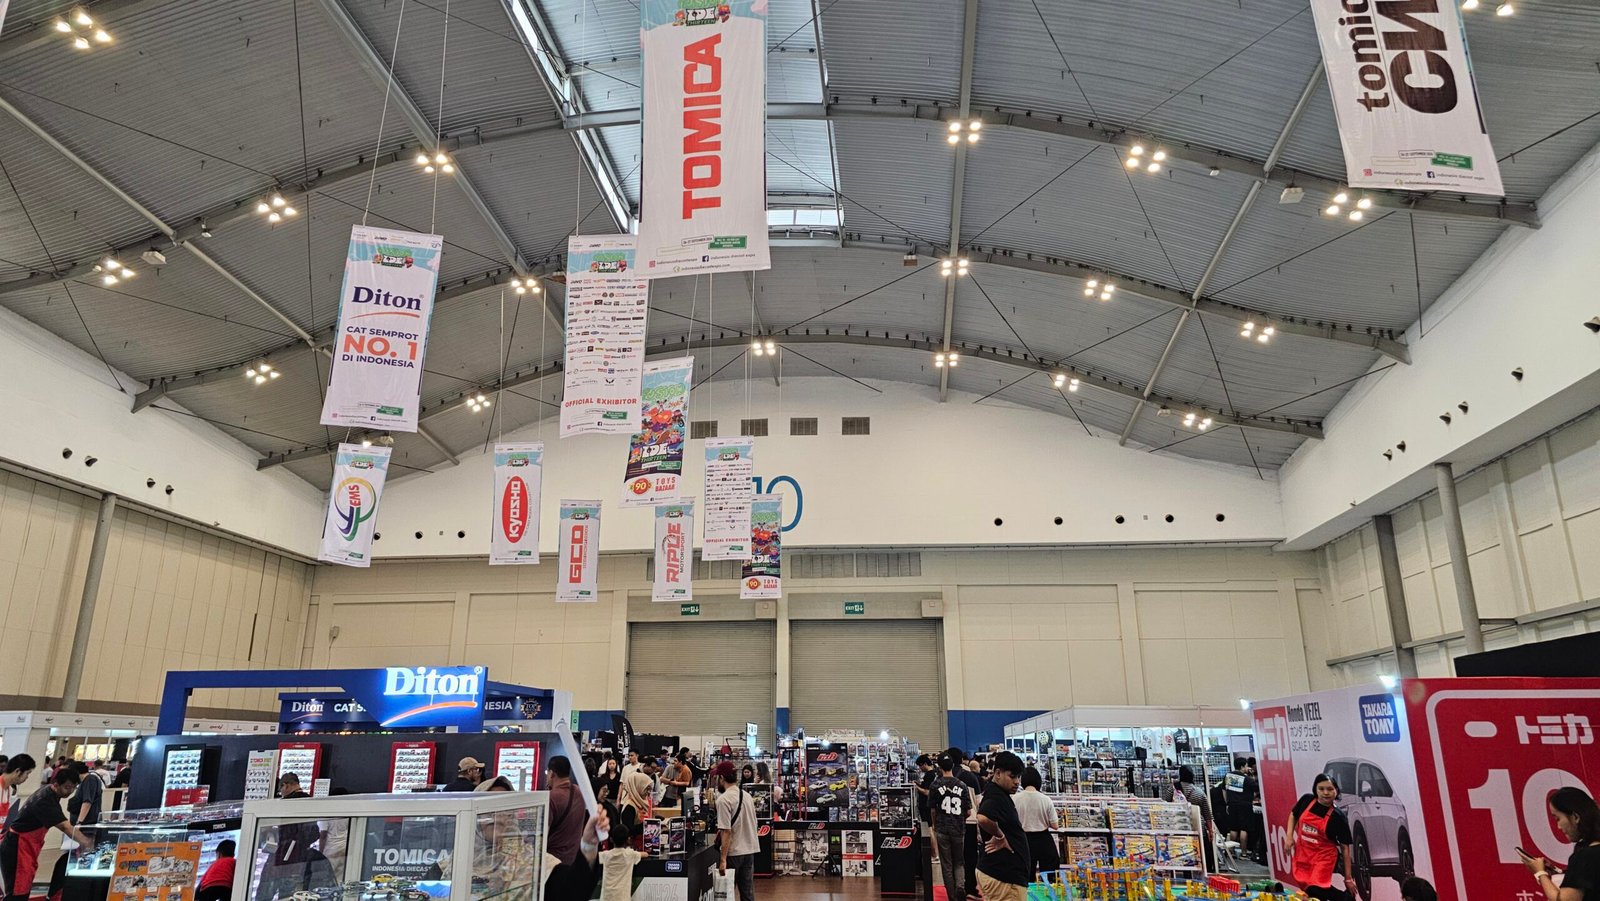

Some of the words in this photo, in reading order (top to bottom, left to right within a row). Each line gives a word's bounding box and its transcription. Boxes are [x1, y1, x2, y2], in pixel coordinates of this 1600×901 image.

[682, 33, 722, 219] TOMICA
[351, 286, 421, 310] Diton
[346, 325, 367, 334] CAT
[369, 328, 419, 340] SEMPROT
[343, 334, 397, 358] NO.
[407, 341, 418, 360] 1
[341, 354, 353, 362] DI
[356, 355, 415, 369] INDONESIA
[564, 398, 594, 408] OFFICIAL
[596, 398, 637, 406] EXHIBITOR
[656, 477, 676, 485] TOYS
[349, 484, 361, 507] EMS
[509, 480, 522, 538] KYOSHO
[383, 666, 479, 695] Diton
[291, 701, 324, 712] Diton
[334, 703, 355, 712] CAT
[1303, 702, 1322, 722] VEZEL
[1362, 702, 1394, 717] TAKARA
[1364, 718, 1396, 735] TOMY
[1514, 713, 1594, 745] トミカ
[1292, 741, 1308, 752] SCALE
[941, 796, 961, 815] 43
[373, 848, 449, 865] TOMICA
